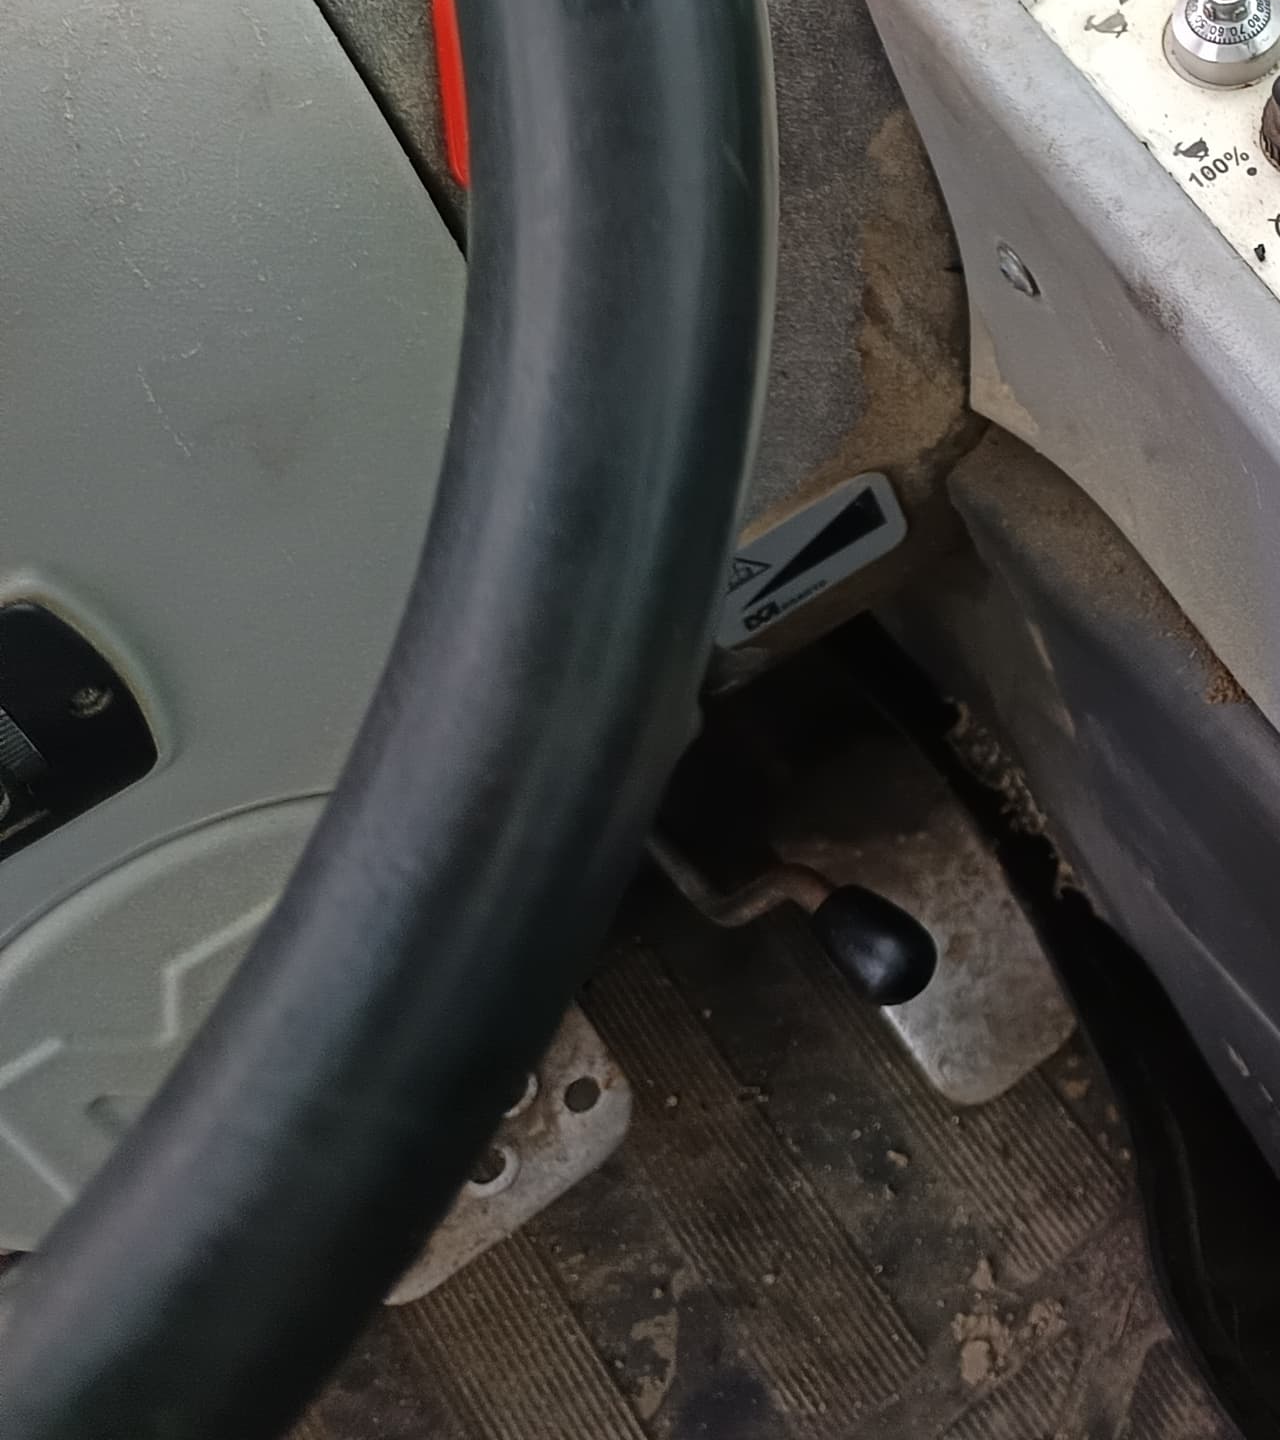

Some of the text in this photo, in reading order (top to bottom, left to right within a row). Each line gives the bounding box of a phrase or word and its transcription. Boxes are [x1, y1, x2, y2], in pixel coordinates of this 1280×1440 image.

[1209, 25, 1225, 37] 60
[1230, 24, 1246, 37] 70
[1188, 146, 1250, 188] 100%
